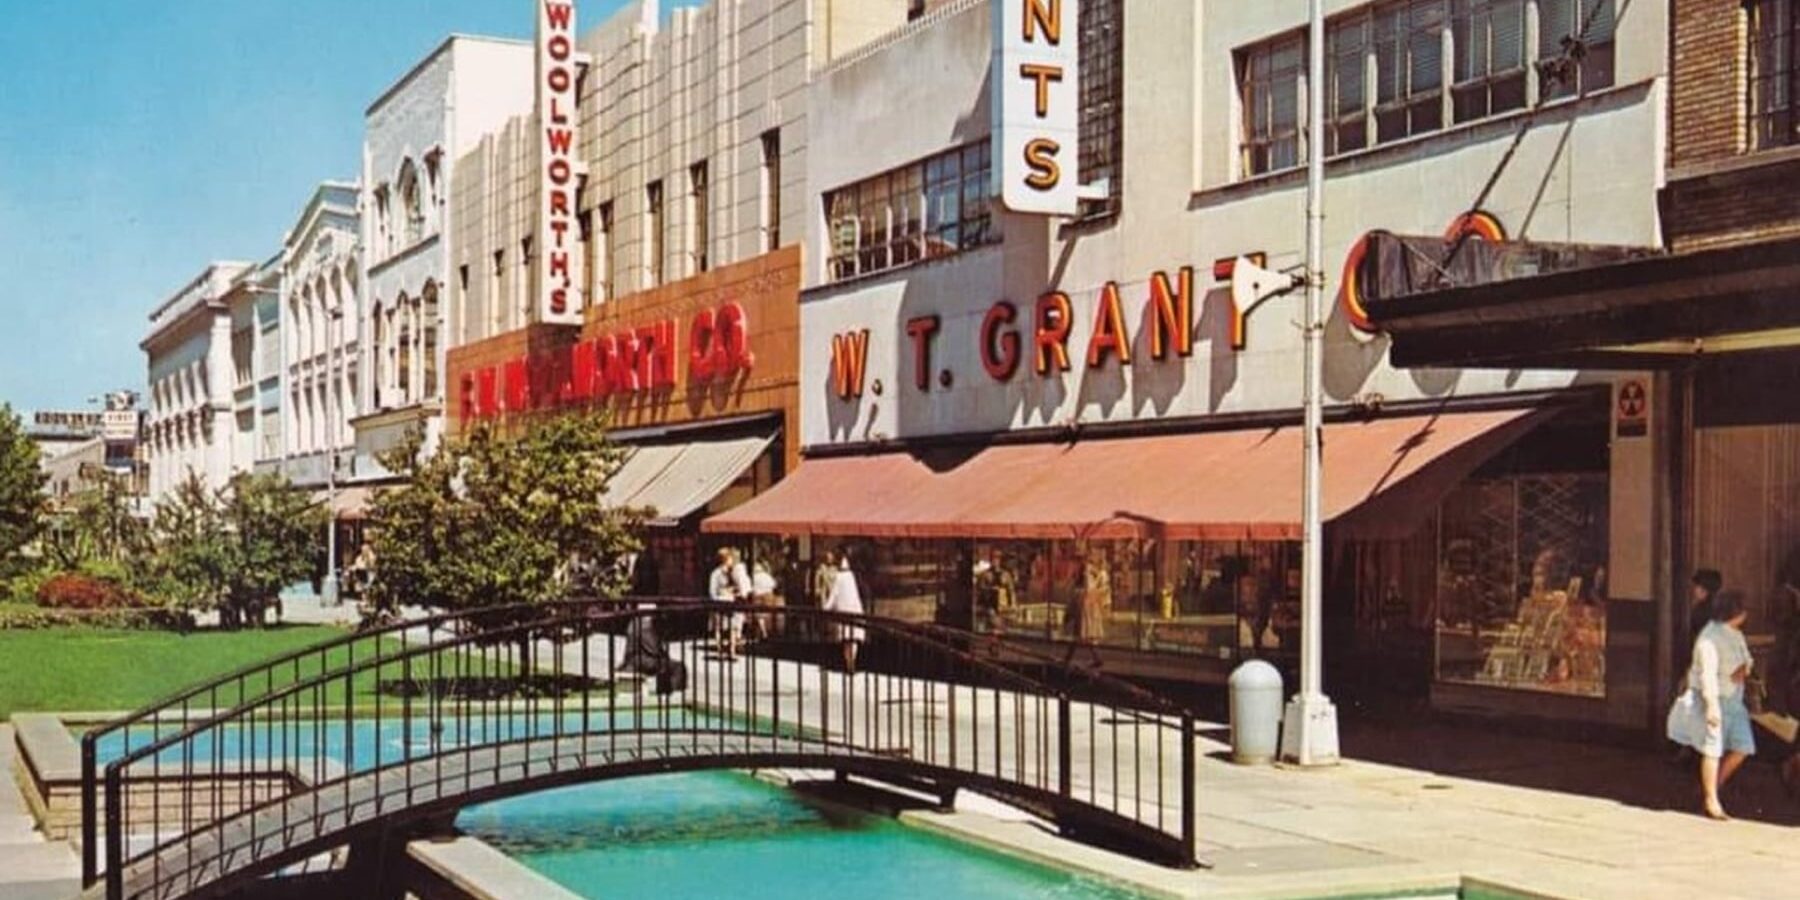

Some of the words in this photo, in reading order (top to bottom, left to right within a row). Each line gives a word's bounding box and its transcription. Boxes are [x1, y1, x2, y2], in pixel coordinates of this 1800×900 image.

[546, 2, 572, 315] WOOLWORTH'S
[1019, 0, 1063, 191] NTS
[832, 329, 882, 398] W.
[906, 314, 954, 391] T.
[979, 250, 1266, 382] GRANT
